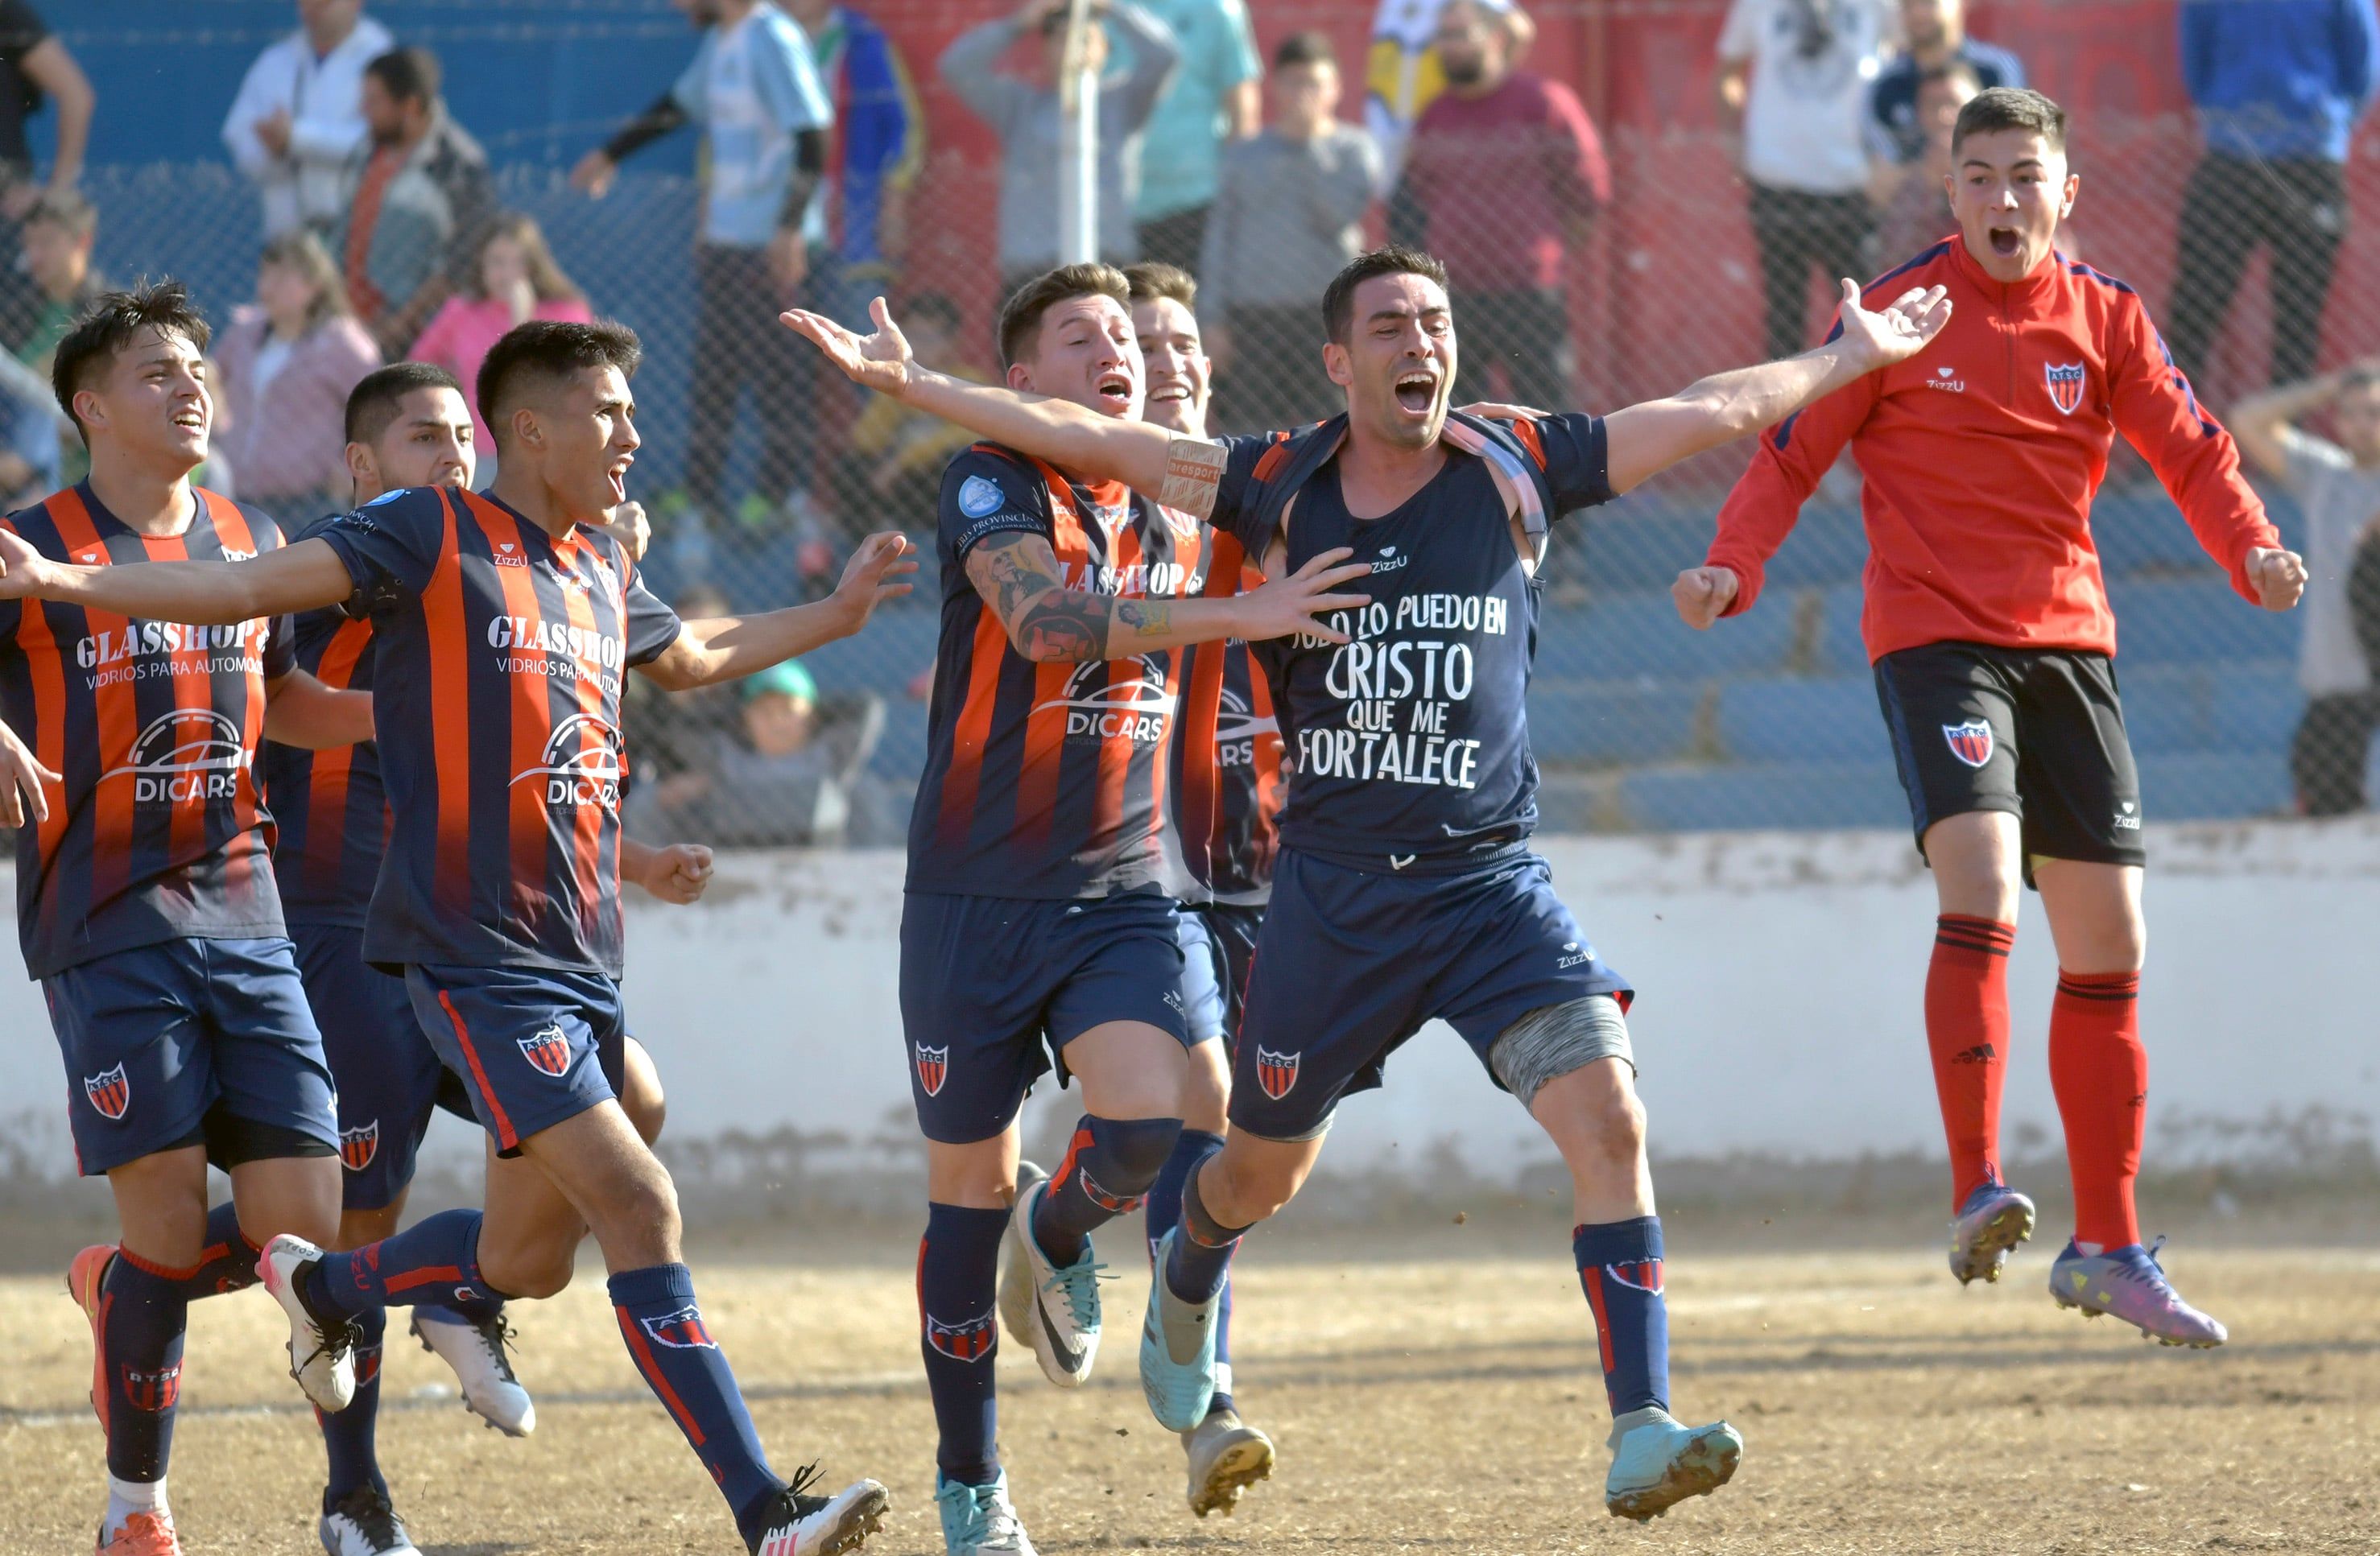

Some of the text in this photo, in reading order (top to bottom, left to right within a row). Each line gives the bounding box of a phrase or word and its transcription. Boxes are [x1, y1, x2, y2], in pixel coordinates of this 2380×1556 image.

[493, 553, 528, 568] ZizzU
[1371, 555, 1407, 573] ZizzU
[1060, 562, 1185, 597] LASSHOP
[1357, 601, 1389, 640] LO
[1395, 593, 1479, 630] PUEDO
[1484, 596, 1507, 635] EN
[76, 620, 255, 669] GLASSHOP
[86, 663, 146, 690] VIDRIOS
[151, 659, 191, 678] PARA
[496, 657, 557, 676] VIDRIOS
[1325, 641, 1473, 701] CRISTO
[1067, 712, 1163, 741] DICARS
[1346, 700, 1450, 734] QUE ME
[1298, 728, 1481, 790] FORTALECE
[135, 772, 237, 803] DICARS
